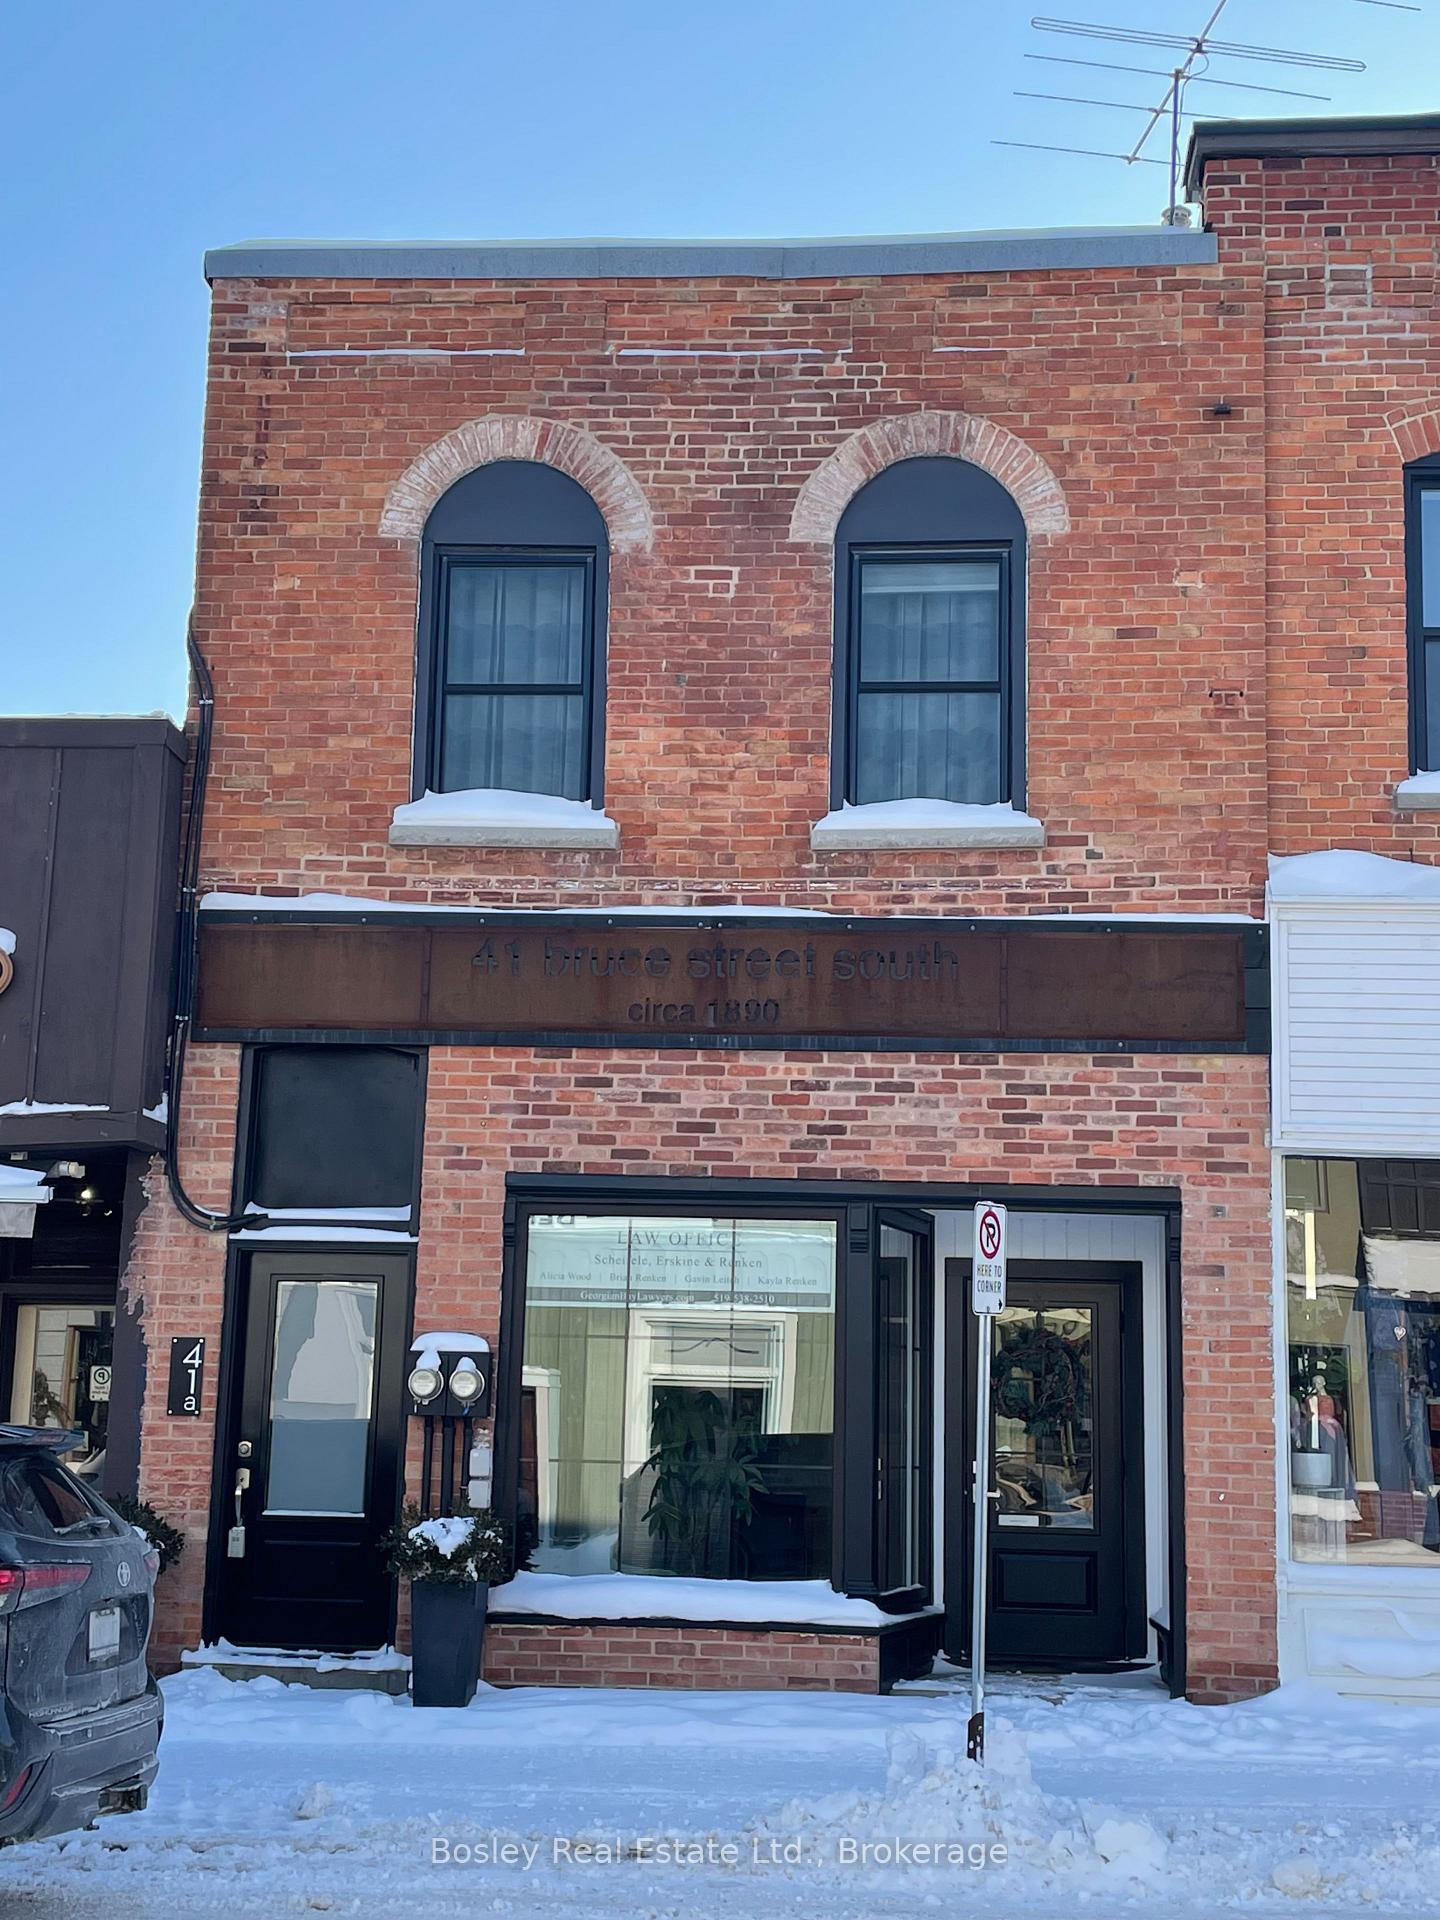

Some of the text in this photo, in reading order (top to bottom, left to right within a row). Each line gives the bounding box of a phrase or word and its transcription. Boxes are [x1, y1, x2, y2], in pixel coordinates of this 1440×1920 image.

[472, 938, 960, 981] 41 bruce street south
[627, 998, 780, 1028] circa 1890
[617, 1231, 660, 1246] LAW
[594, 1254, 652, 1267] Scheiele,
[656, 1255, 700, 1267] Erskine
[704, 1256, 715, 1267] &
[977, 1264, 1003, 1278] HERE TO
[567, 1272, 592, 1281] Wood
[757, 1276, 783, 1287] Kayla
[977, 1280, 1002, 1293] CORNER
